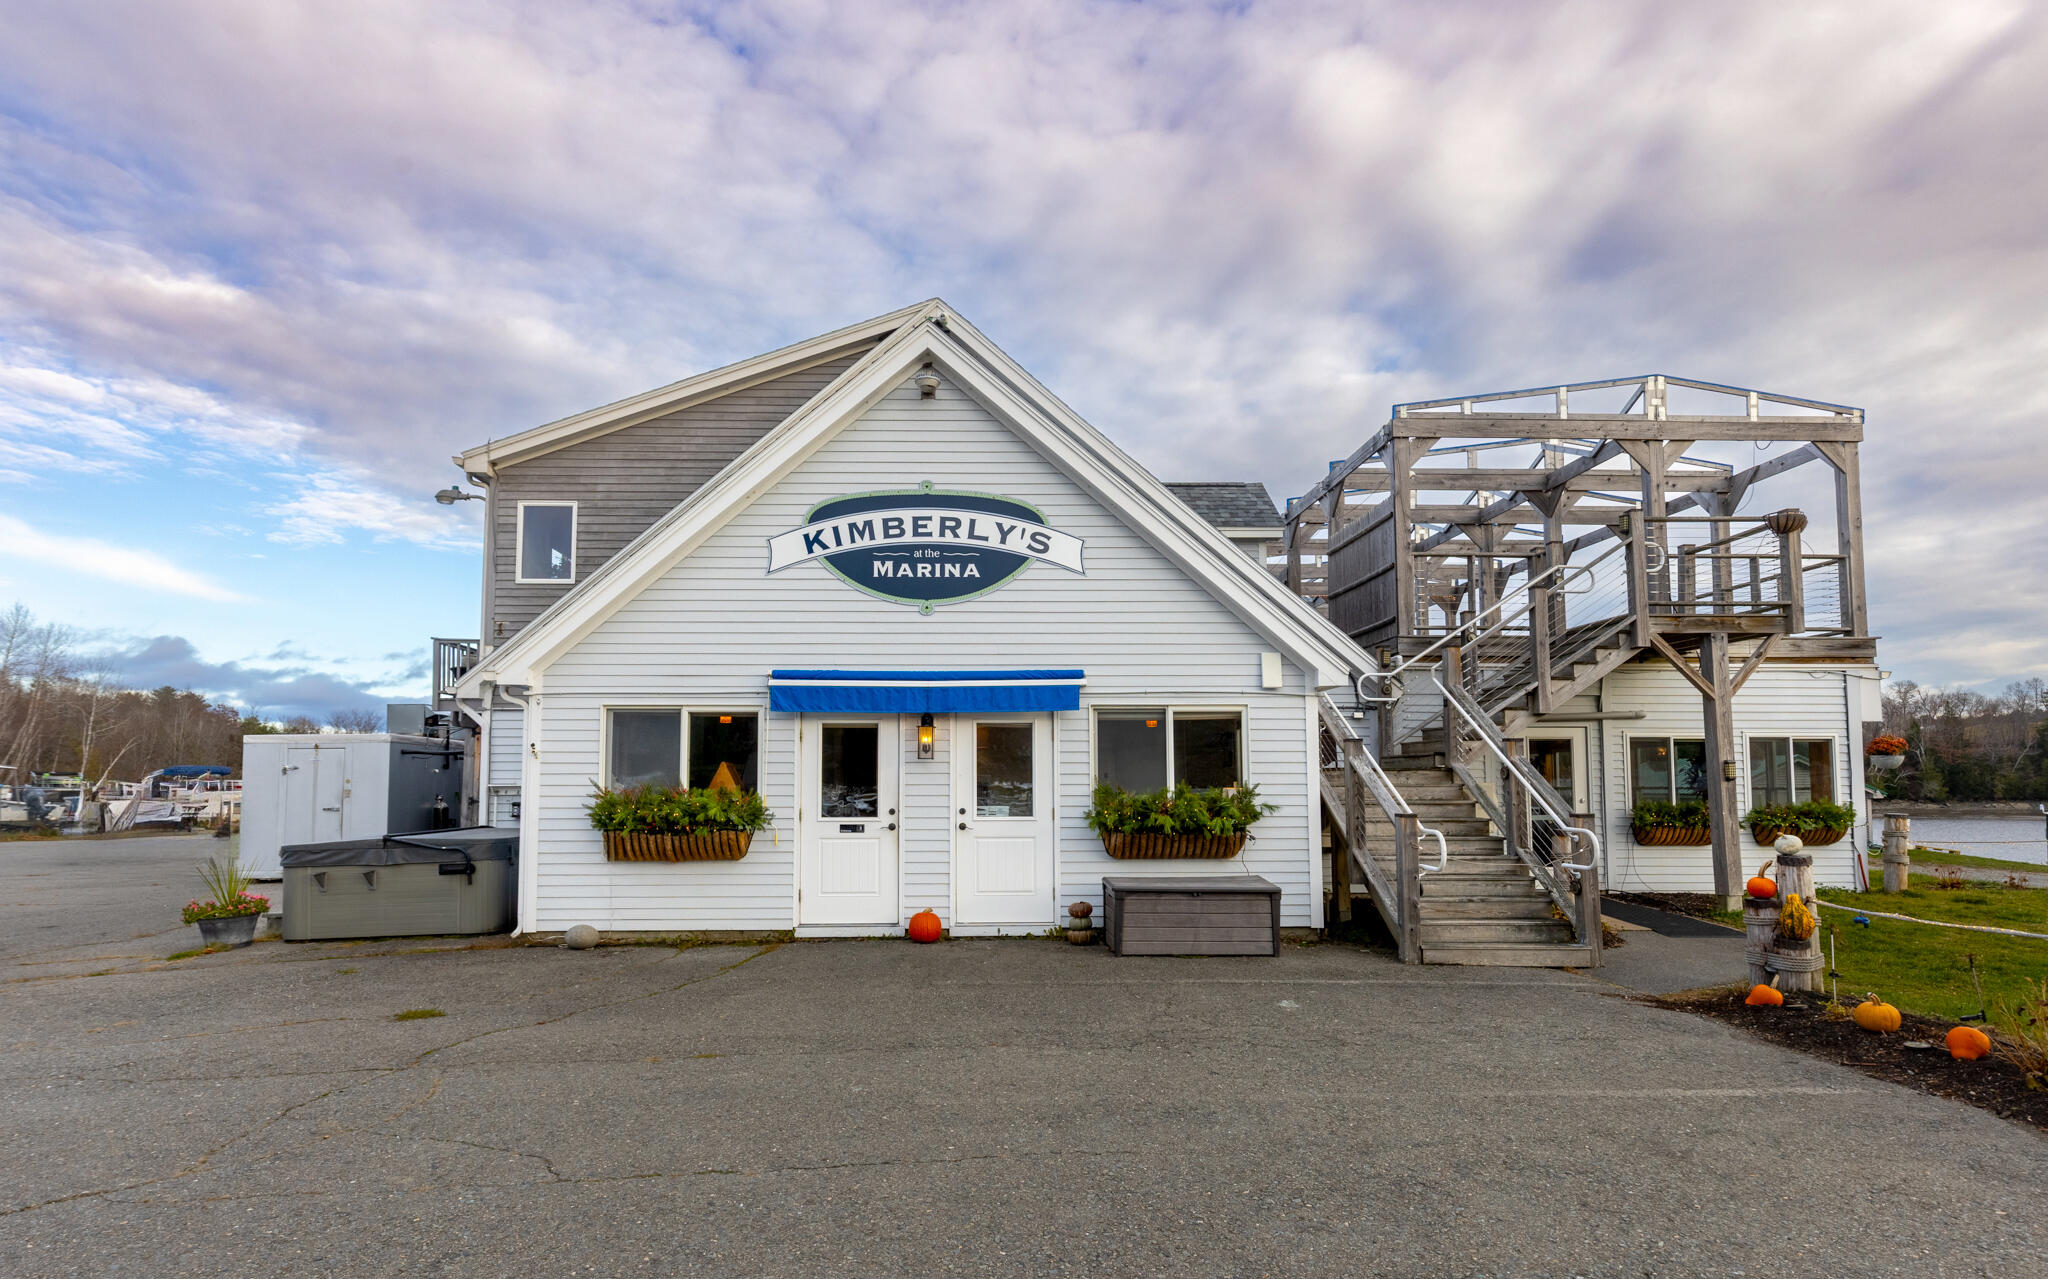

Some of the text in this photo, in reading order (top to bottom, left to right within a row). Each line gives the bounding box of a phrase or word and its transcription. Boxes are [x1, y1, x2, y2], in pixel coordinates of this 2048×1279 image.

[803, 516, 1052, 554] KIMBERLY'S
[913, 548, 940, 558] at the
[872, 560, 980, 578] MARINA
